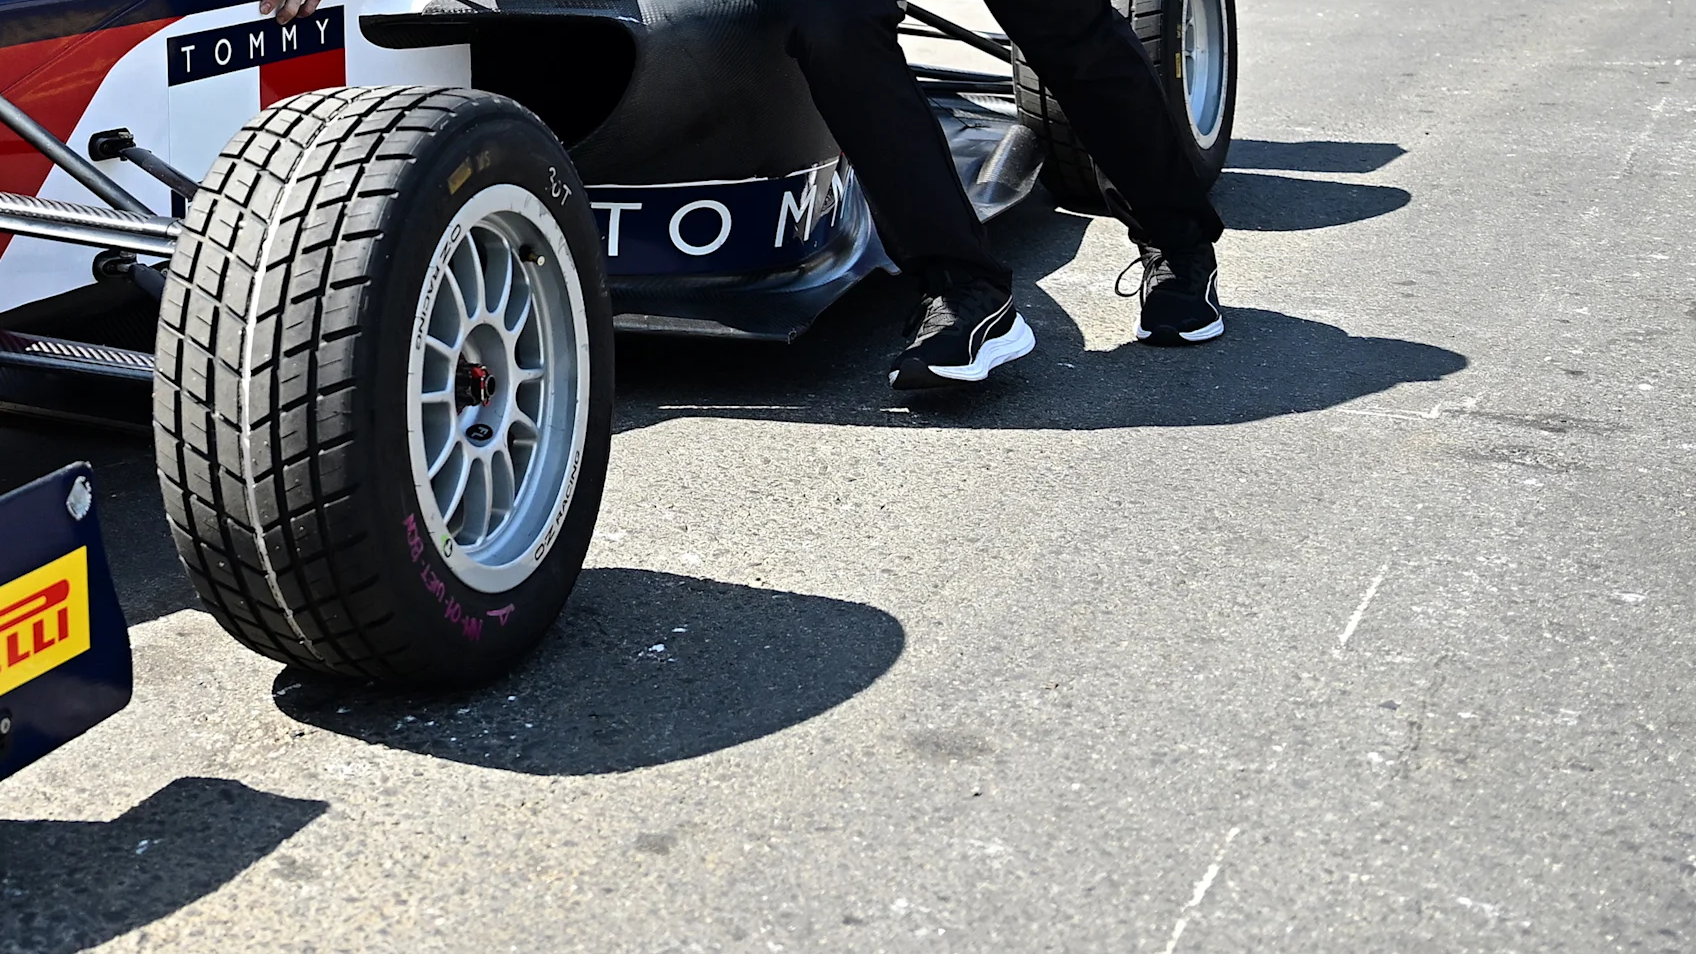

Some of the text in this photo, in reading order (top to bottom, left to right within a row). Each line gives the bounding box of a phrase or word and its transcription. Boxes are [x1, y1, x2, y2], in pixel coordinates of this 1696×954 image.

[181, 17, 330, 73] TOMMY
[415, 265, 441, 351] RACING
[555, 450, 580, 526] RACING
